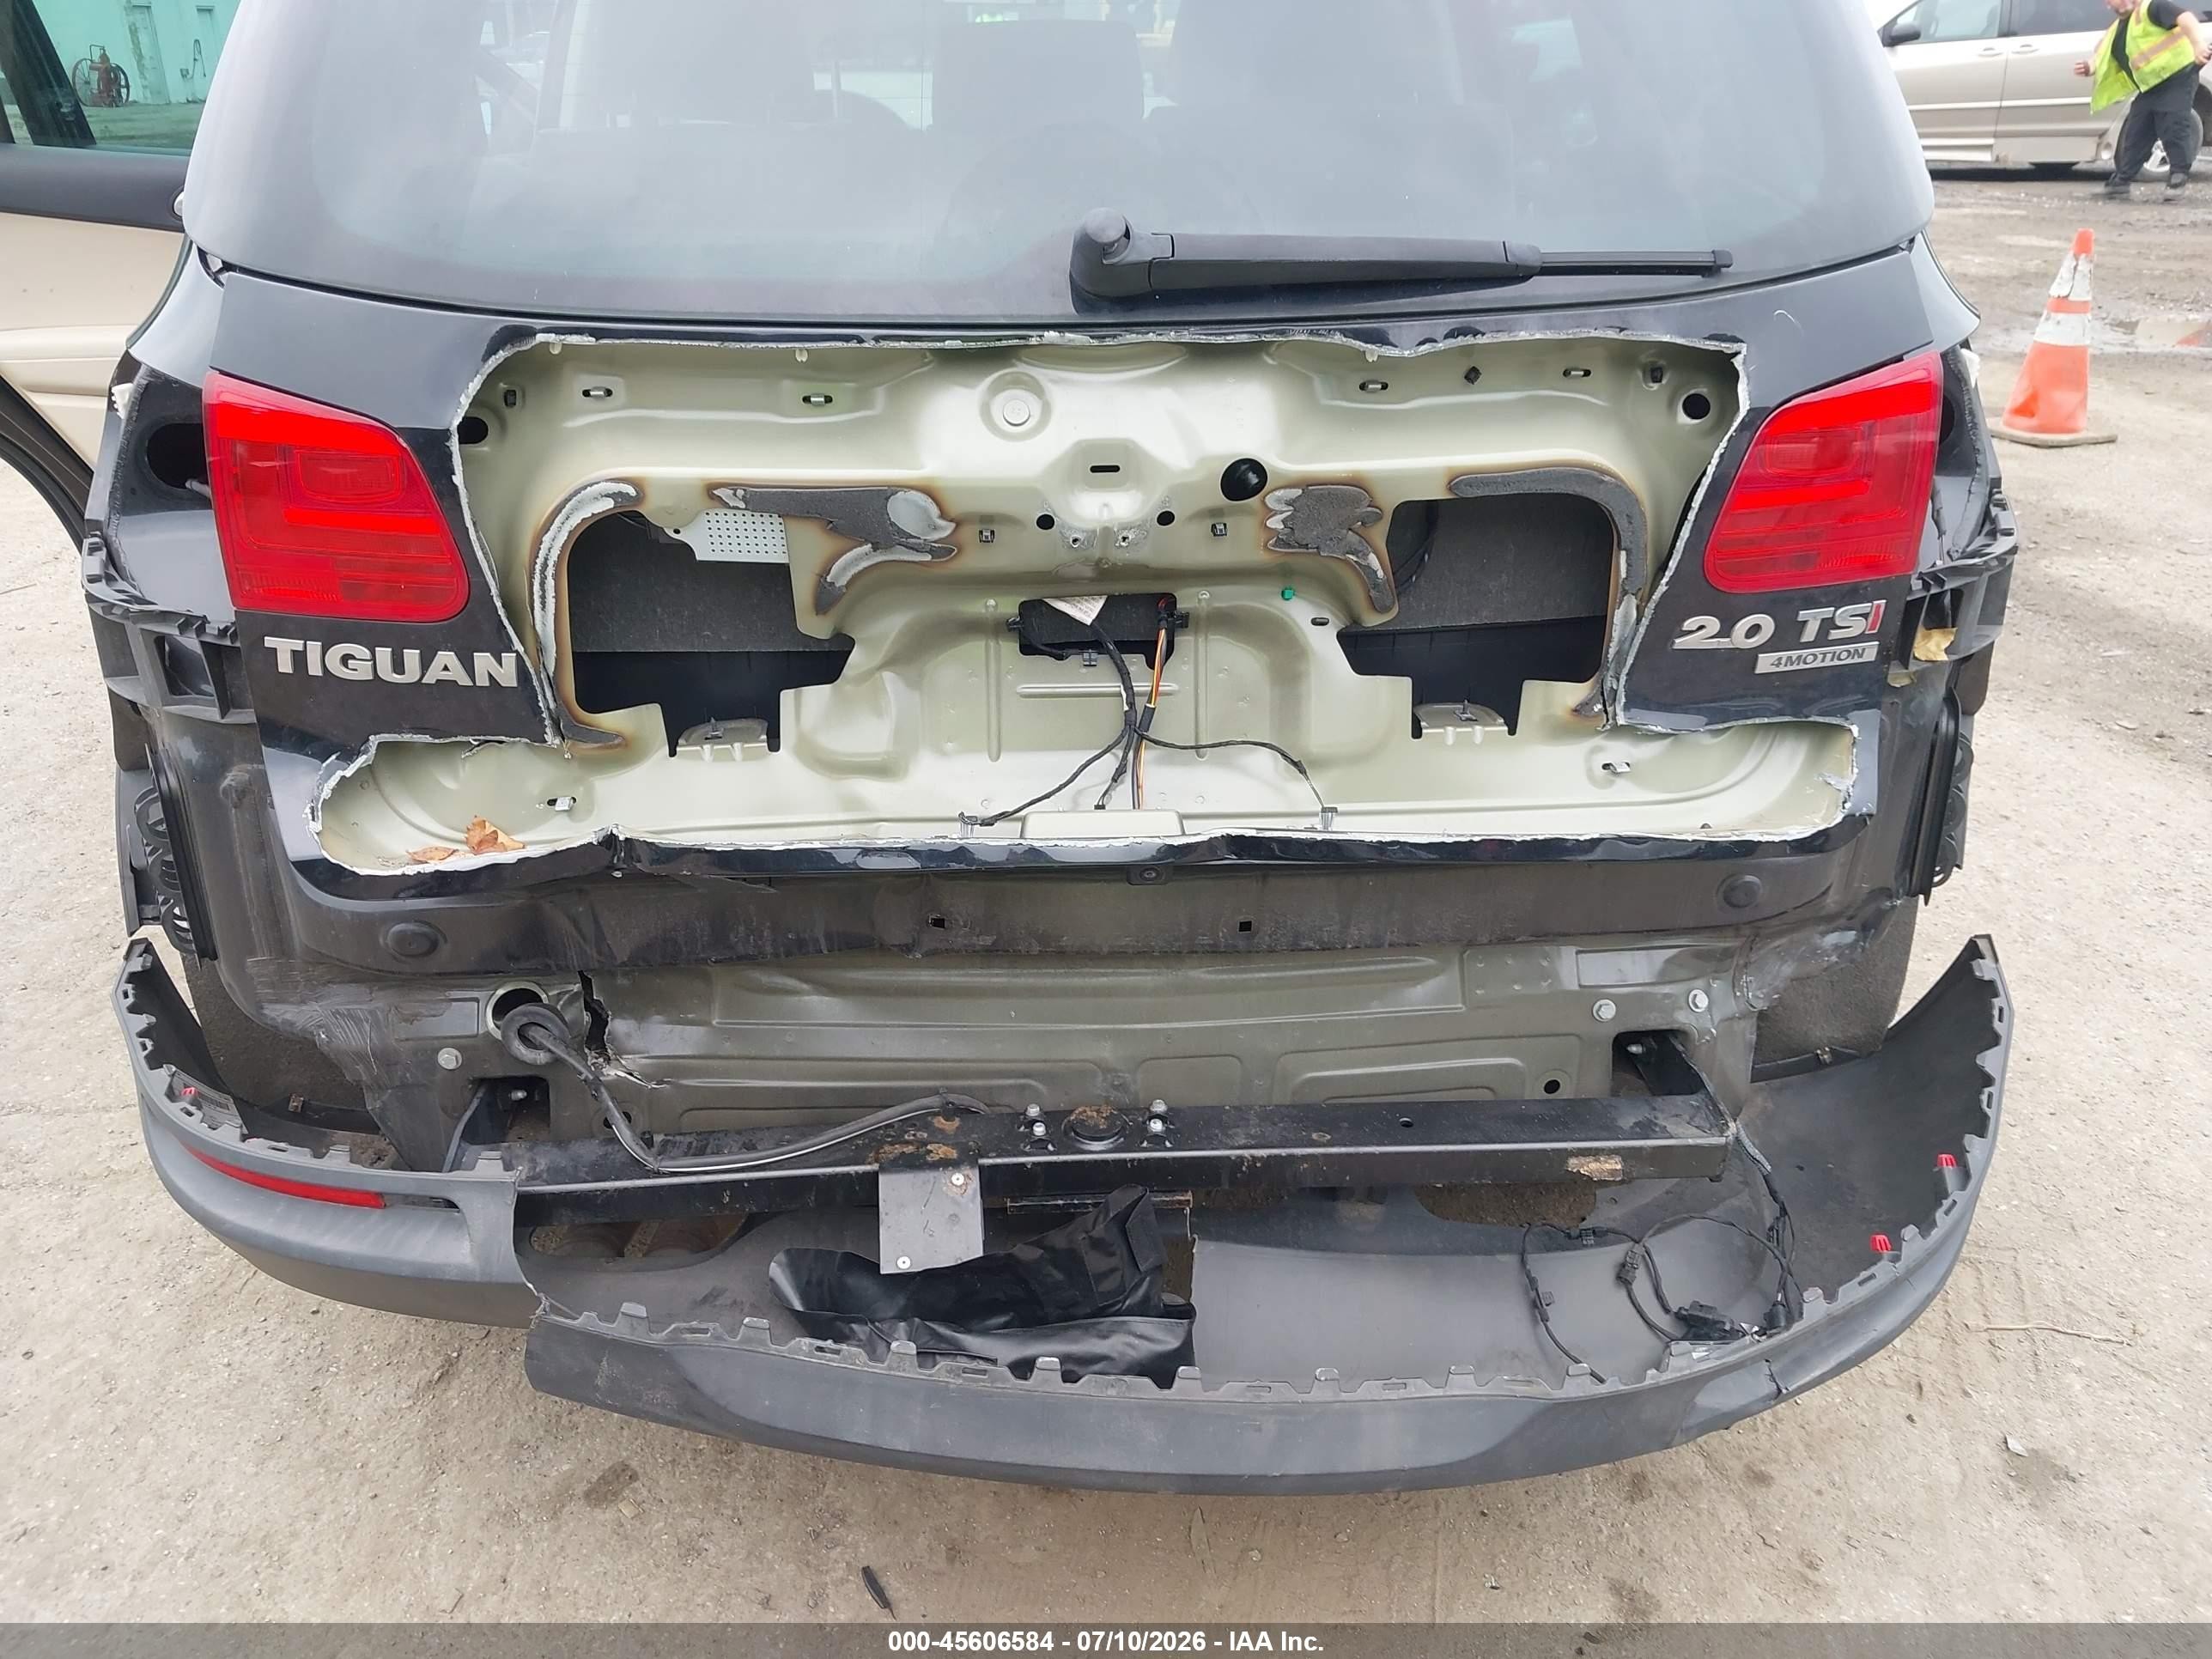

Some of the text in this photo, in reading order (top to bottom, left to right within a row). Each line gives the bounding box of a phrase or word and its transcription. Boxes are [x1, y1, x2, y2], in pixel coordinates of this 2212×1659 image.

[1797, 599, 1887, 642] TSI
[264, 635, 518, 687] TIGUAN
[1770, 648, 1867, 668] 4MOTION
